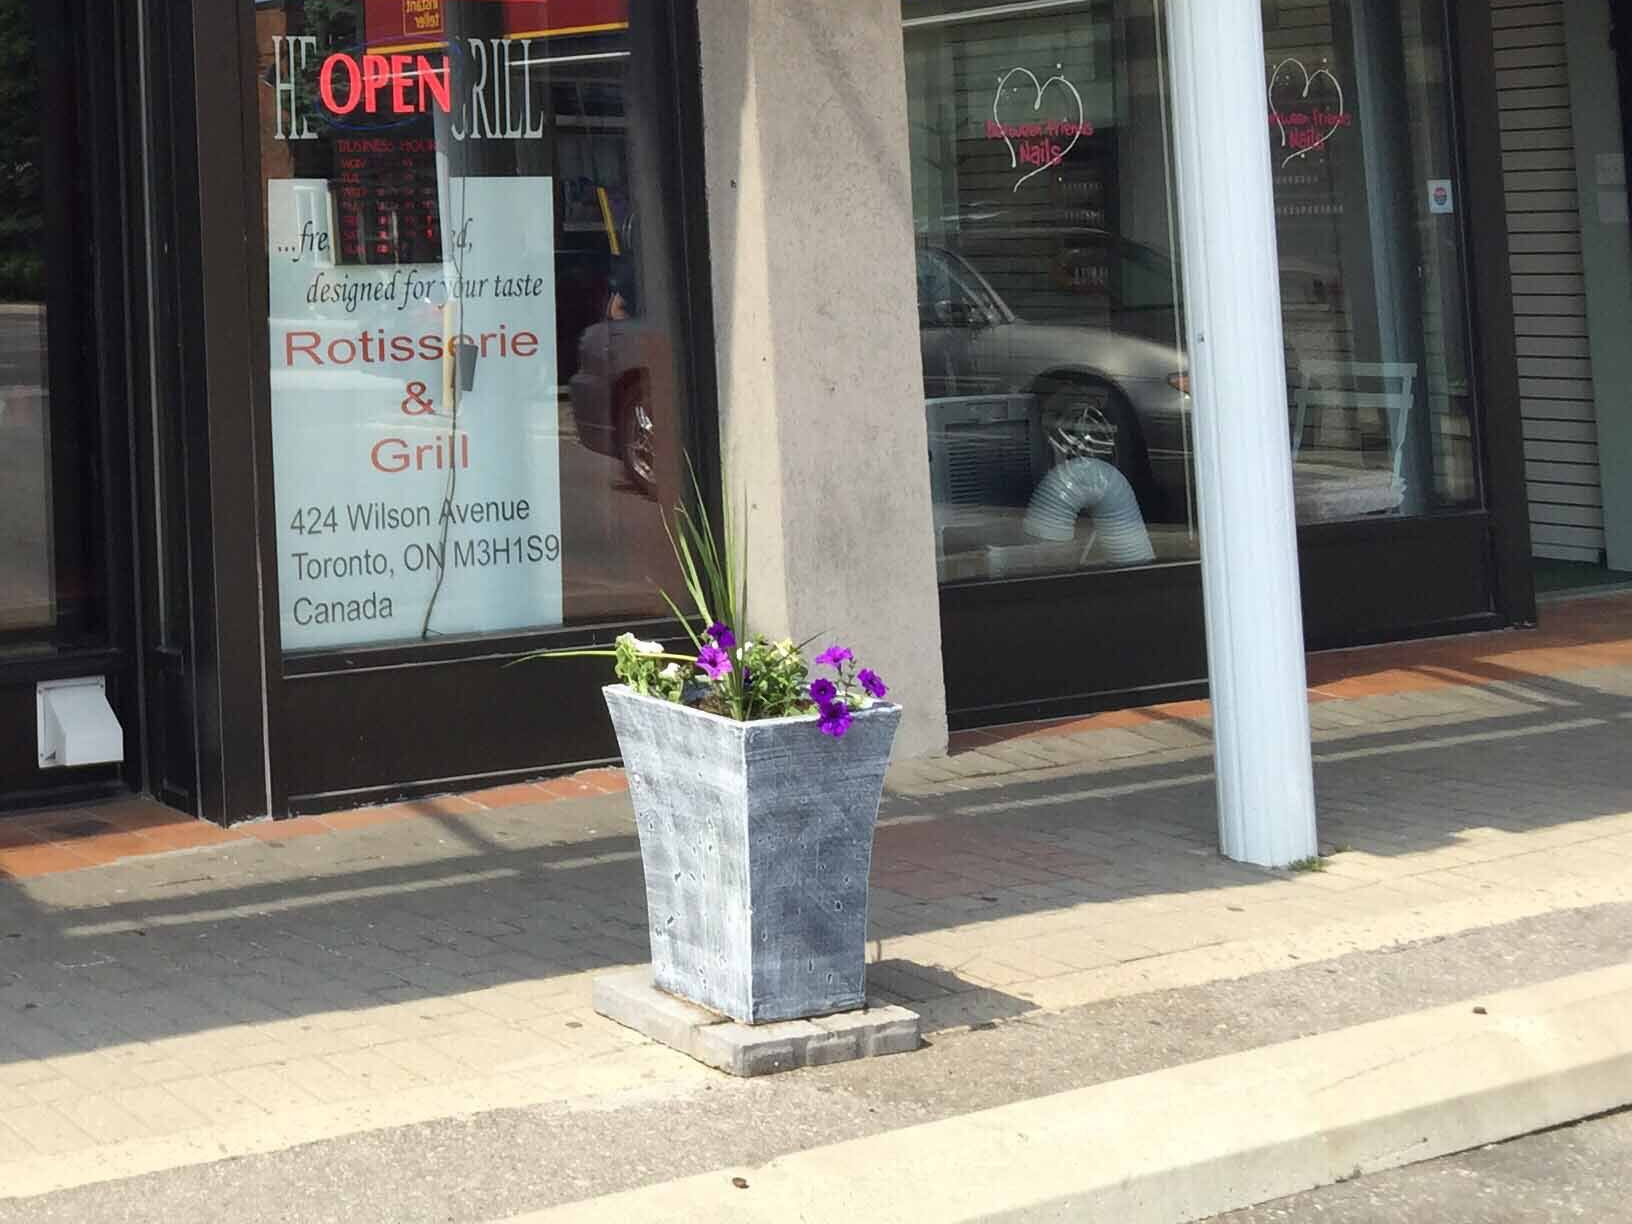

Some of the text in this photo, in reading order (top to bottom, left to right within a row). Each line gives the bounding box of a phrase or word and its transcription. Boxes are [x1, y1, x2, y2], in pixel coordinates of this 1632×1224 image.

[319, 52, 451, 115] OPEN
[306, 272, 402, 313] designed
[397, 269, 437, 311] for
[494, 274, 543, 297] taste
[401, 381, 435, 416] &
[370, 434, 469, 474] Grill
[290, 497, 531, 536] 424 Wilson Avenue
[292, 533, 561, 582] Toronto, ON M3H1S9
[293, 592, 393, 627] Canada
